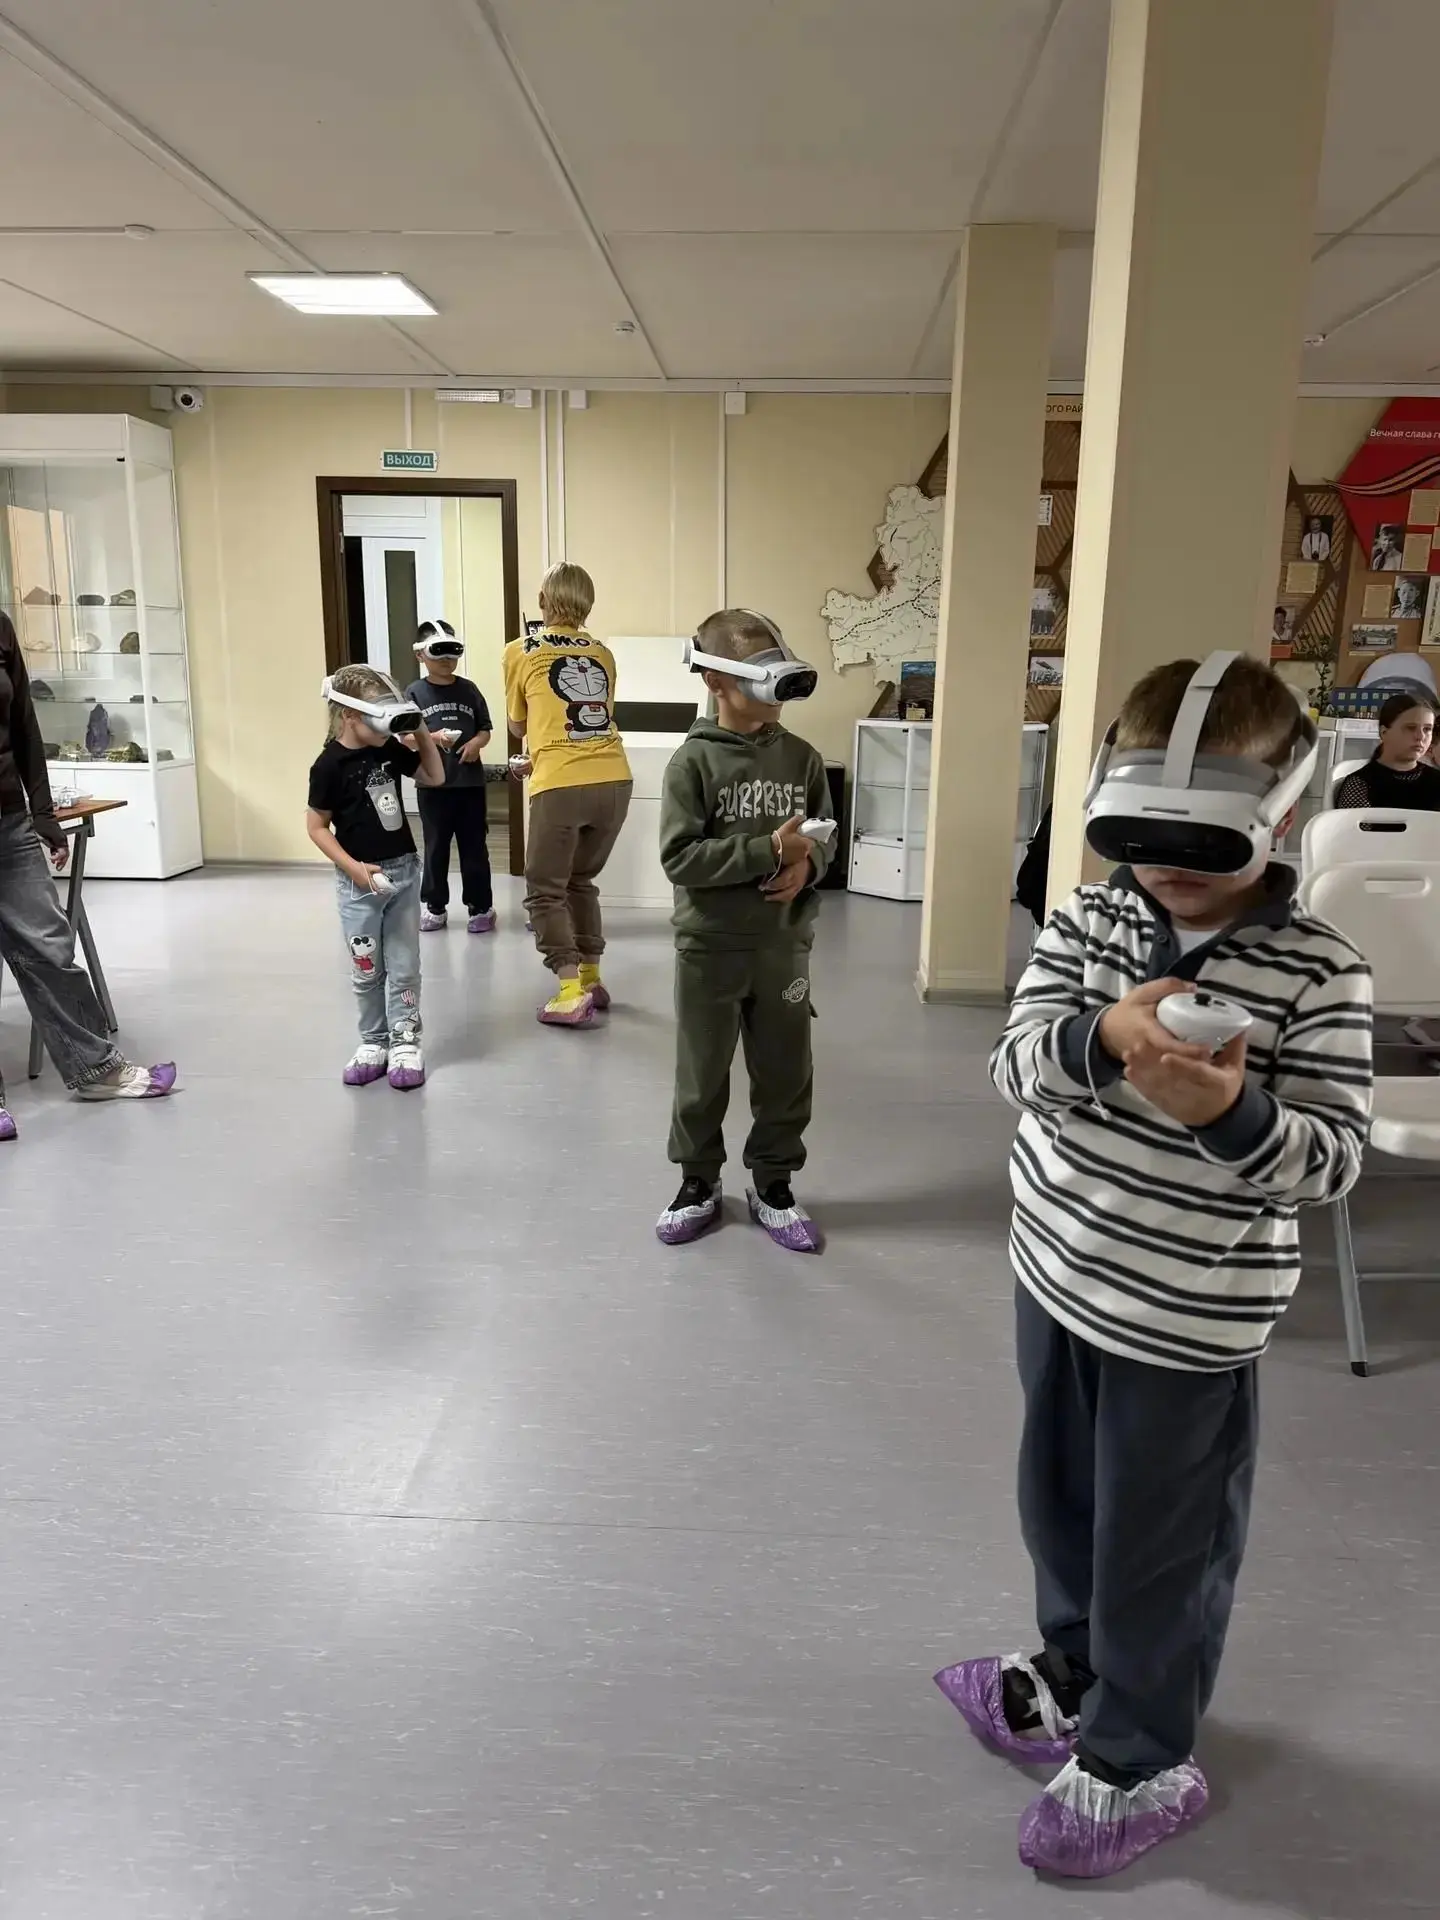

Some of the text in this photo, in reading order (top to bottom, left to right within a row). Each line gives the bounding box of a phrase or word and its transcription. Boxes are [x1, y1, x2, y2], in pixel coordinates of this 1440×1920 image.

[1370, 428, 1404, 438] Вечная
[1405, 430, 1432, 439] слава
[386, 454, 431, 466] ВЫХОД
[715, 779, 805, 824] SURPRISE
